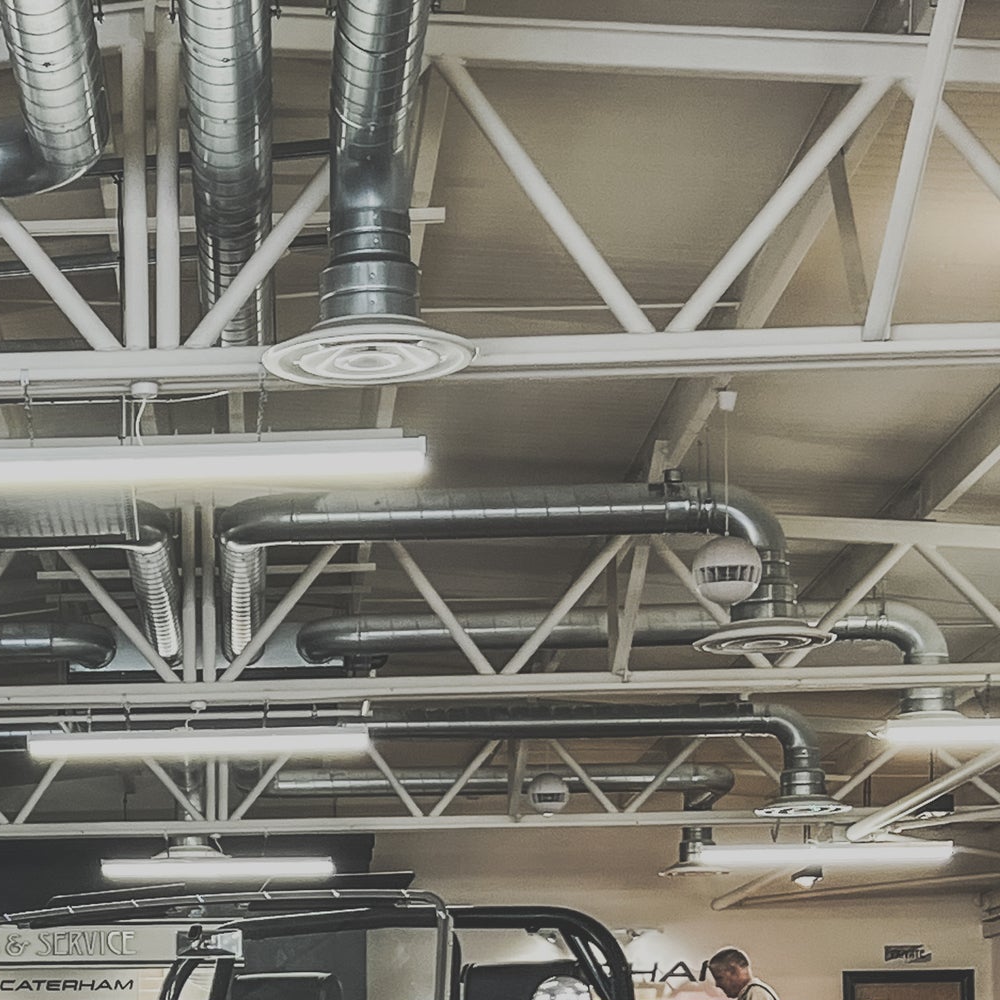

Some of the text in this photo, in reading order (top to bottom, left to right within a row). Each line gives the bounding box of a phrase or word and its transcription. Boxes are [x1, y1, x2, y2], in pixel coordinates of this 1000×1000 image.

[5, 933, 31, 957] &
[36, 930, 137, 957] SERVICE
[0, 979, 134, 992] CATERHAM
